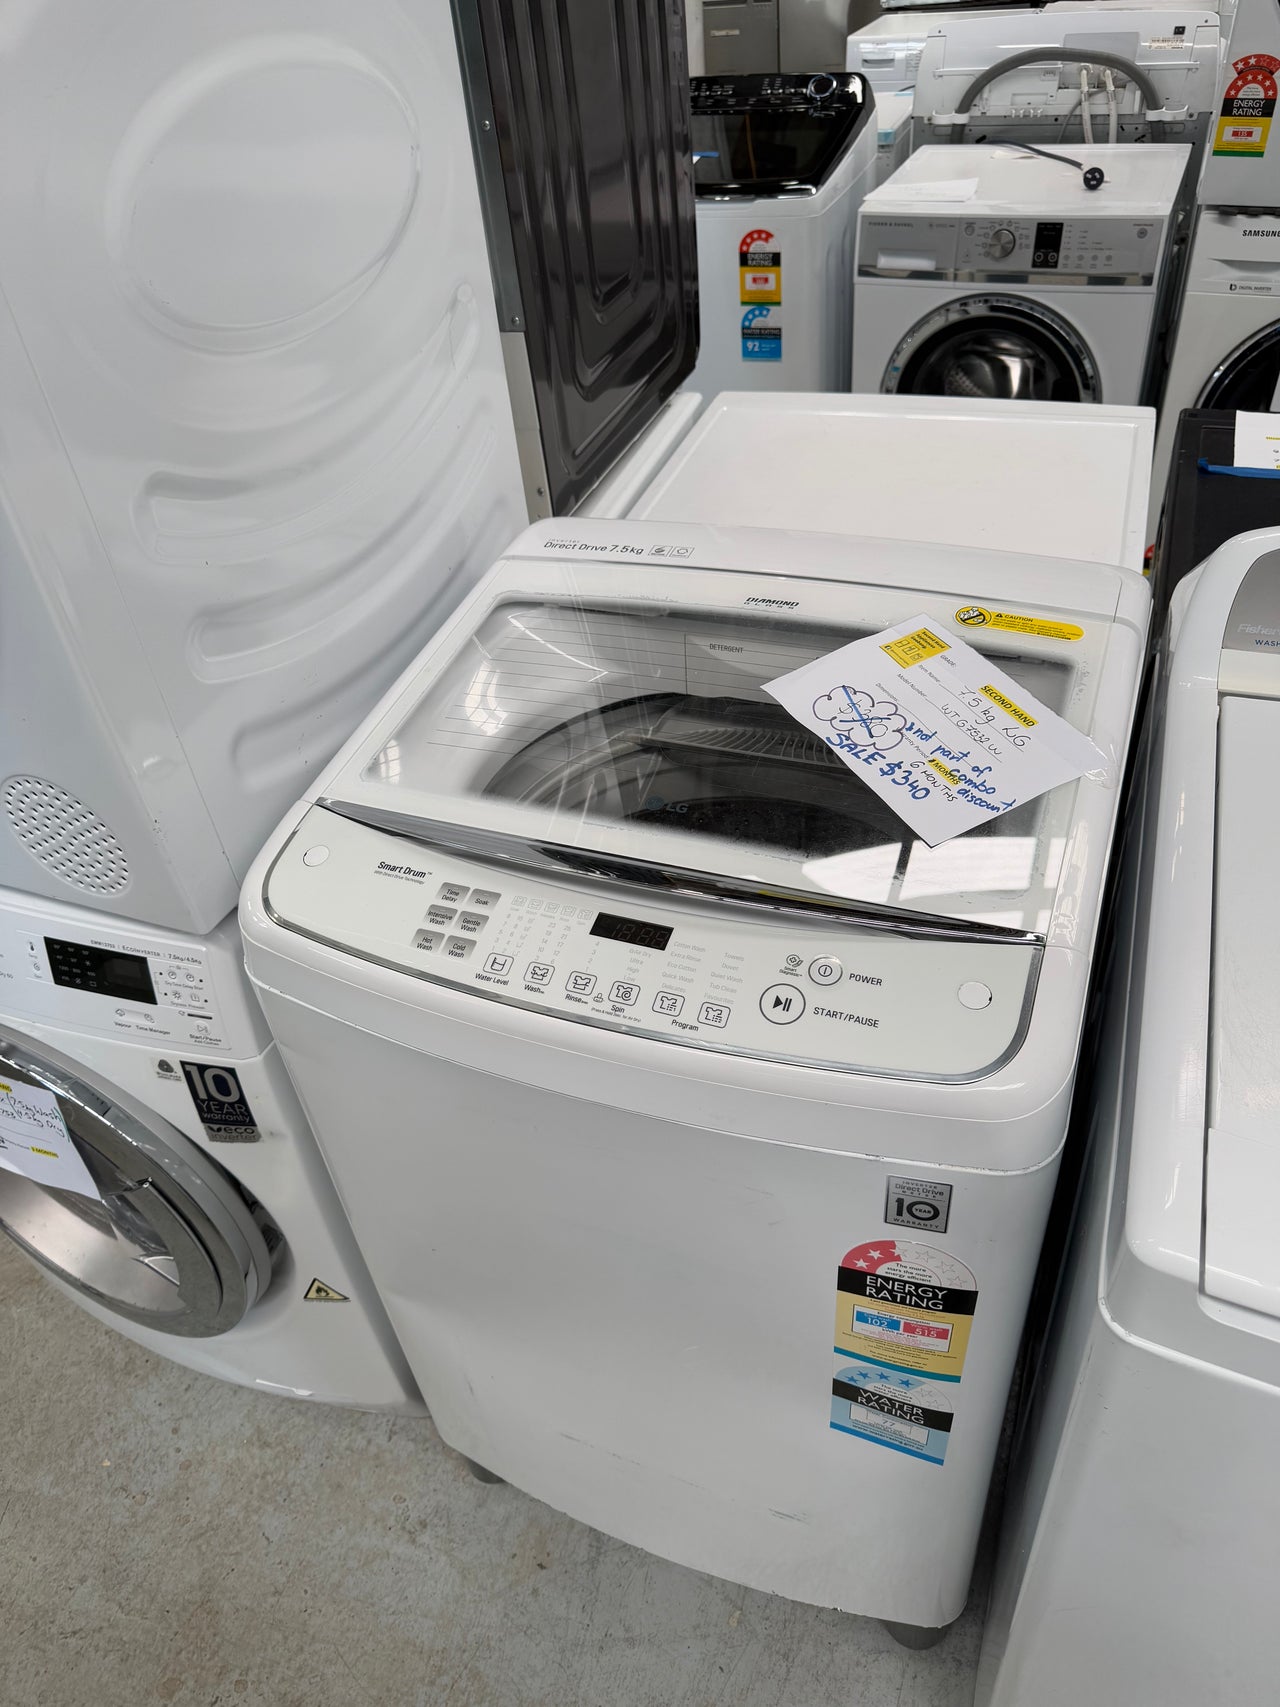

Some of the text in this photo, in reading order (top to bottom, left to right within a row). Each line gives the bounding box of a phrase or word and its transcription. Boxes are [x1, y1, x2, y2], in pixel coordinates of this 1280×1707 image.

[1233, 99, 1265, 108] ENERGY
[1232, 108, 1262, 116] RATING
[747, 341, 759, 352] 92
[544, 541, 644, 555] Direct Drive 7.5kg
[746, 597, 800, 606] DIAMOND
[1004, 614, 1033, 622] CAUTION
[710, 643, 743, 653] DETERGENT
[980, 684, 1035, 727] SECOND HAND
[912, 727, 993, 778] not part of
[825, 733, 931, 800] SALE $340
[921, 770, 958, 802] MONTHS
[664, 803, 689, 814] LG
[377, 861, 404, 873] Smart
[446, 888, 460, 897] Time
[441, 894, 458, 903] Delay
[474, 898, 490, 906] Soak
[428, 911, 453, 921] Intensive
[429, 918, 446, 926] Wash
[462, 917, 481, 927] Gentle
[460, 924, 477, 933] Wash
[416, 943, 433, 951] Wash
[452, 943, 466, 952] Cold
[448, 950, 465, 958] Wash
[475, 972, 509, 986] Water Level
[848, 973, 883, 986] POWER
[610, 1004, 625, 1014] Spin
[813, 1006, 880, 1028] START/PAUSE
[671, 1019, 699, 1031] Program
[184, 1064, 241, 1103] 10
[198, 1099, 248, 1116] YEAR
[201, 1112, 250, 1123] warranty
[895, 1183, 944, 1196] Direct Drive
[902, 1181, 937, 1189] INVERTER
[895, 1197, 940, 1221] 10
[893, 1217, 939, 1229] WARRANTY
[885, 1271, 931, 1283] energy efficient
[866, 1275, 948, 1299] ENERGY
[865, 1286, 944, 1310] RATING
[868, 1318, 888, 1328] 102
[914, 1328, 937, 1338] 515
[860, 1389, 924, 1417] WATER
[857, 1396, 924, 1424] RATING
